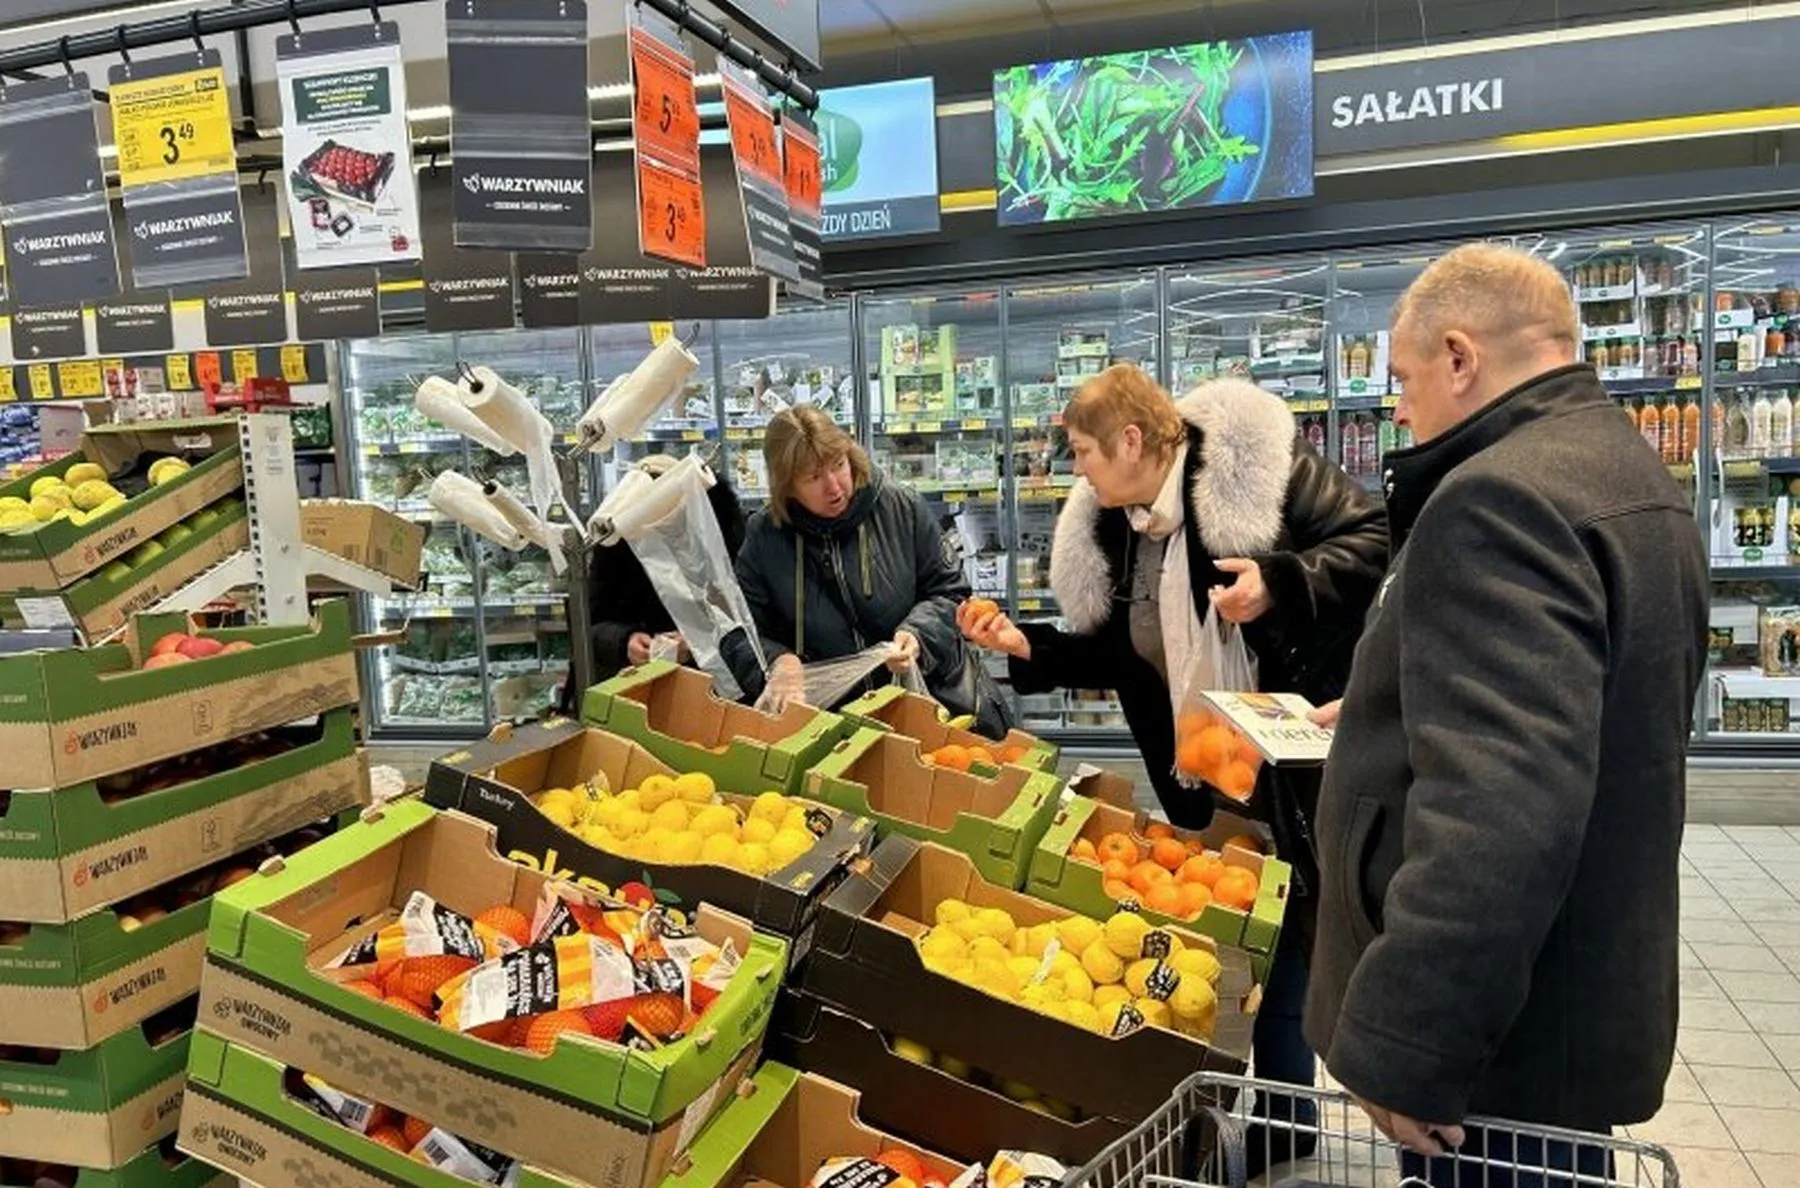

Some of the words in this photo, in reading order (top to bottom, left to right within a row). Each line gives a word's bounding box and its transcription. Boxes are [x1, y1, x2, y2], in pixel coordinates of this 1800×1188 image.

[659, 94, 671, 134] 5
[1331, 78, 1505, 128] SAŁATKI
[160, 127, 180, 165] 3
[179, 122, 195, 139] 49
[480, 176, 585, 194] WARZYWNIAK
[148, 210, 234, 235] WARZYWNIAK
[665, 203, 676, 242] 3
[850, 203, 891, 232] DZIEŃ
[26, 230, 106, 251] WARZYWNIAK
[598, 269, 669, 280] WARZYWNIAK
